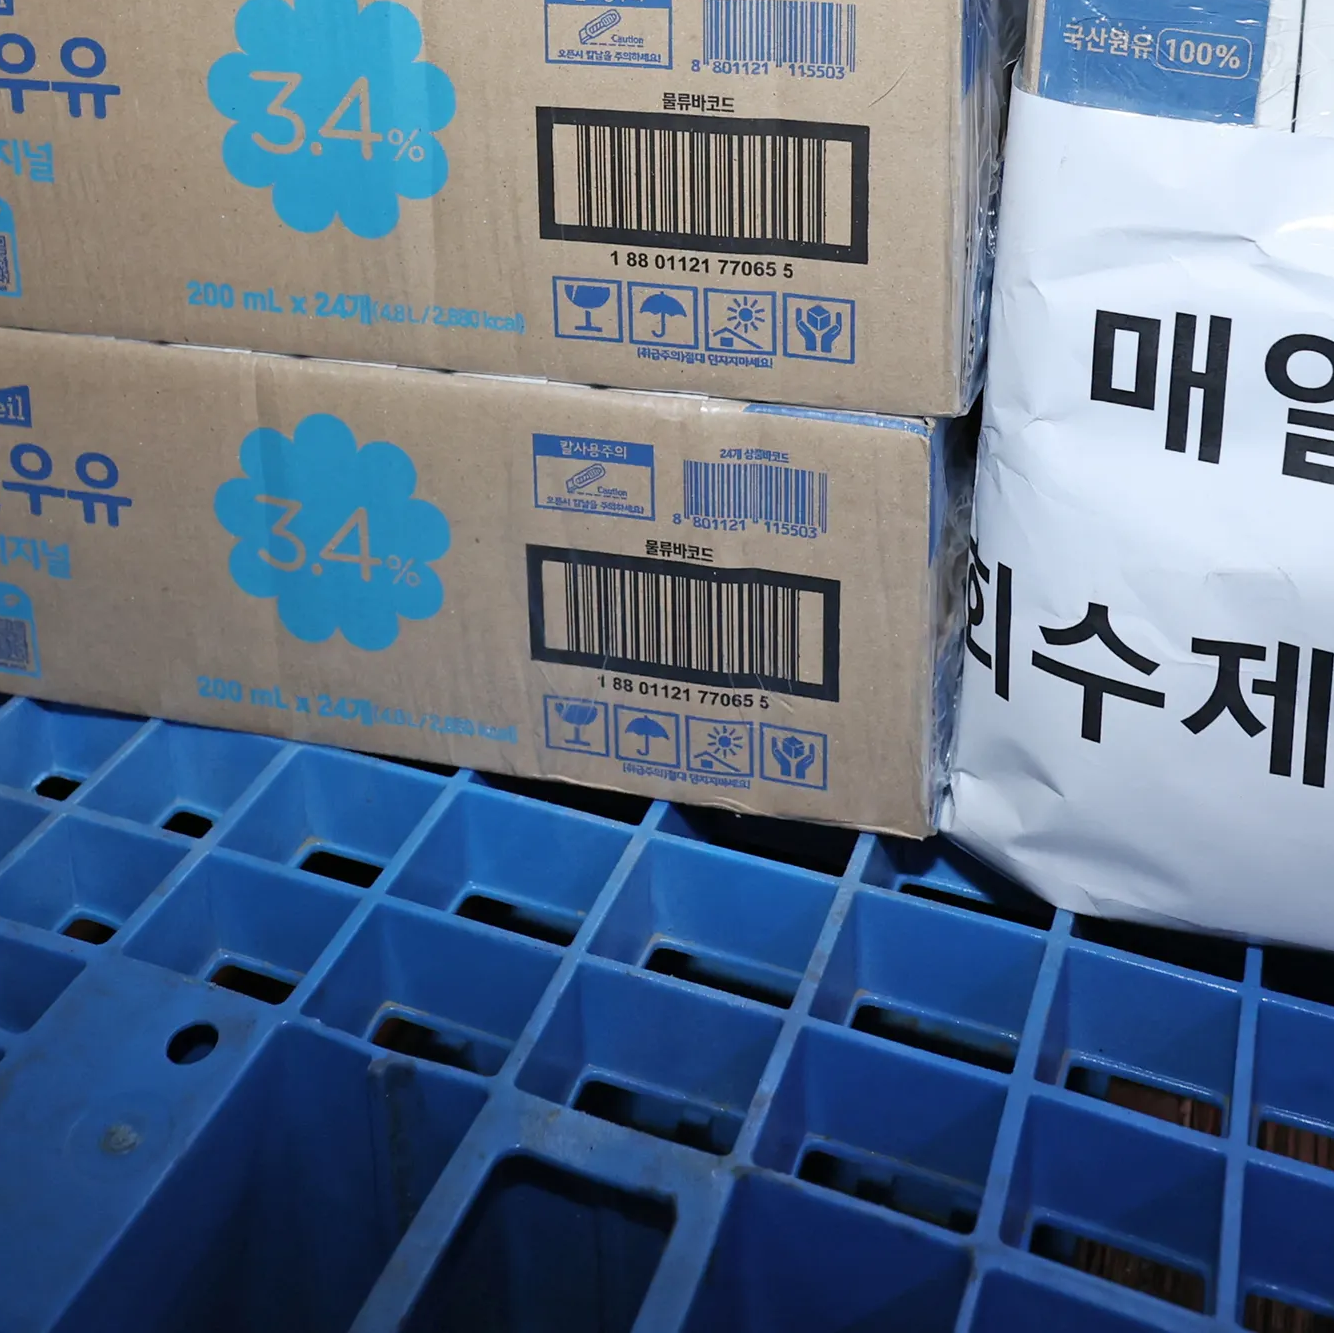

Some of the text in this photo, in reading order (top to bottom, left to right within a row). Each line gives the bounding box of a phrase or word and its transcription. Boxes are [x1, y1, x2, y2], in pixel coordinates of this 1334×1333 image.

[611, 34, 644, 45] Caution
[1063, 24, 1241, 70] 국산원유 100%
[691, 59, 845, 80] 8 801121 115503
[662, 92, 735, 113] 물류바코드
[610, 251, 793, 278] 1 88 01121 77065 5
[186, 280, 235, 309] 200
[242, 287, 283, 314] mL
[560, 440, 627, 459] 칼사용주의
[673, 513, 817, 538] 8 801121 115503
[645, 539, 713, 563] 물류바코드
[613, 677, 633, 692] 88
[639, 682, 690, 701] 01121
[698, 690, 754, 708] 77065
[759, 696, 769, 709] 5
